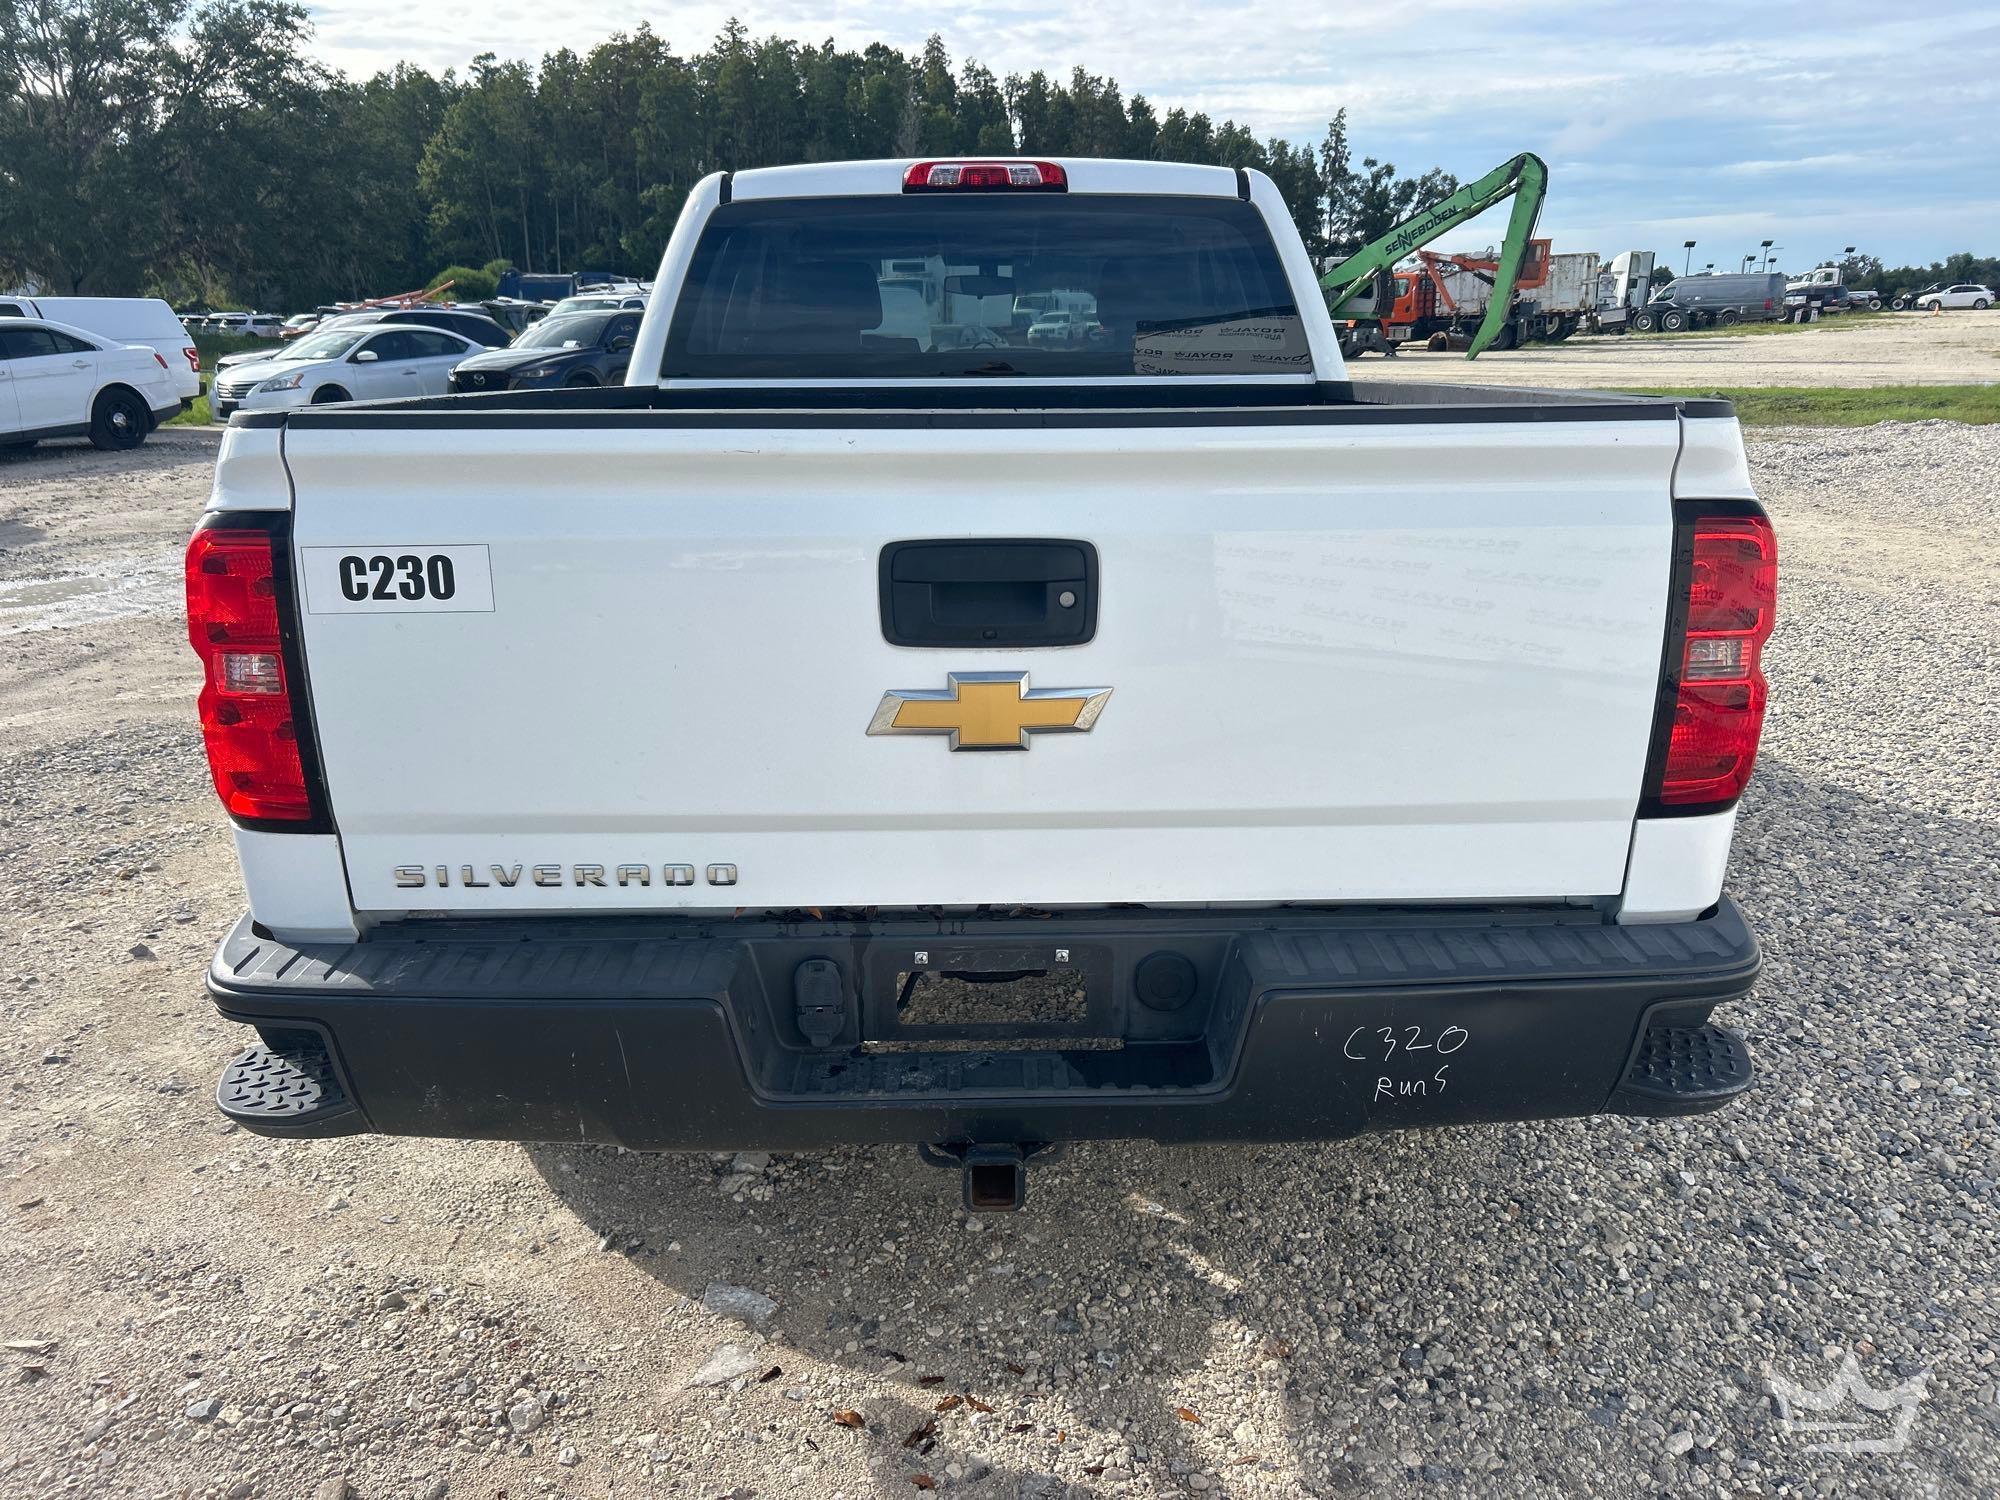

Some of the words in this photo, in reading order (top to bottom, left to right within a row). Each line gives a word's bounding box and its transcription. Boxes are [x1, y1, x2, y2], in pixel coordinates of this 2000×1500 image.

[1385, 205, 1457, 256] SENNEBOGEN
[339, 554, 456, 602] C230
[394, 863, 738, 888] SILVERADO
[1343, 1026, 1469, 1062] C320
